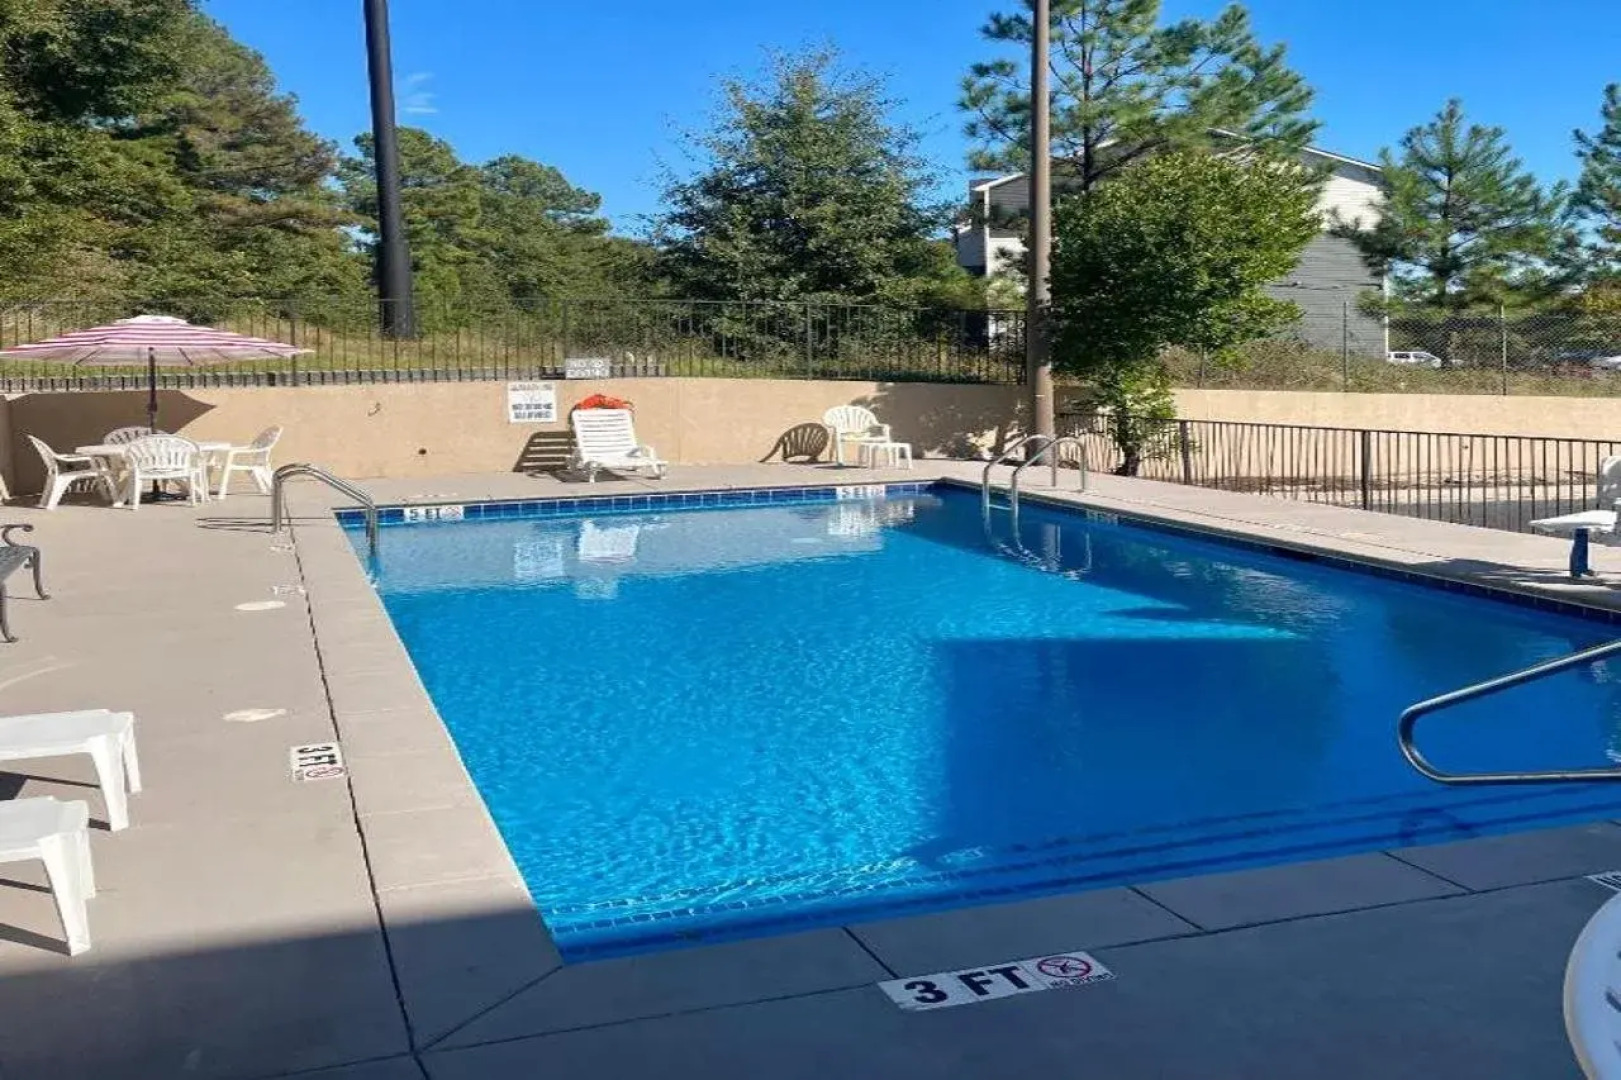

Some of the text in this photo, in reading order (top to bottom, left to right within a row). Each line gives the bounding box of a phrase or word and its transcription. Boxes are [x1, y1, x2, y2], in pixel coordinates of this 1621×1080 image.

[298, 754, 336, 766] FT
[905, 966, 1030, 1003] 3 FT
